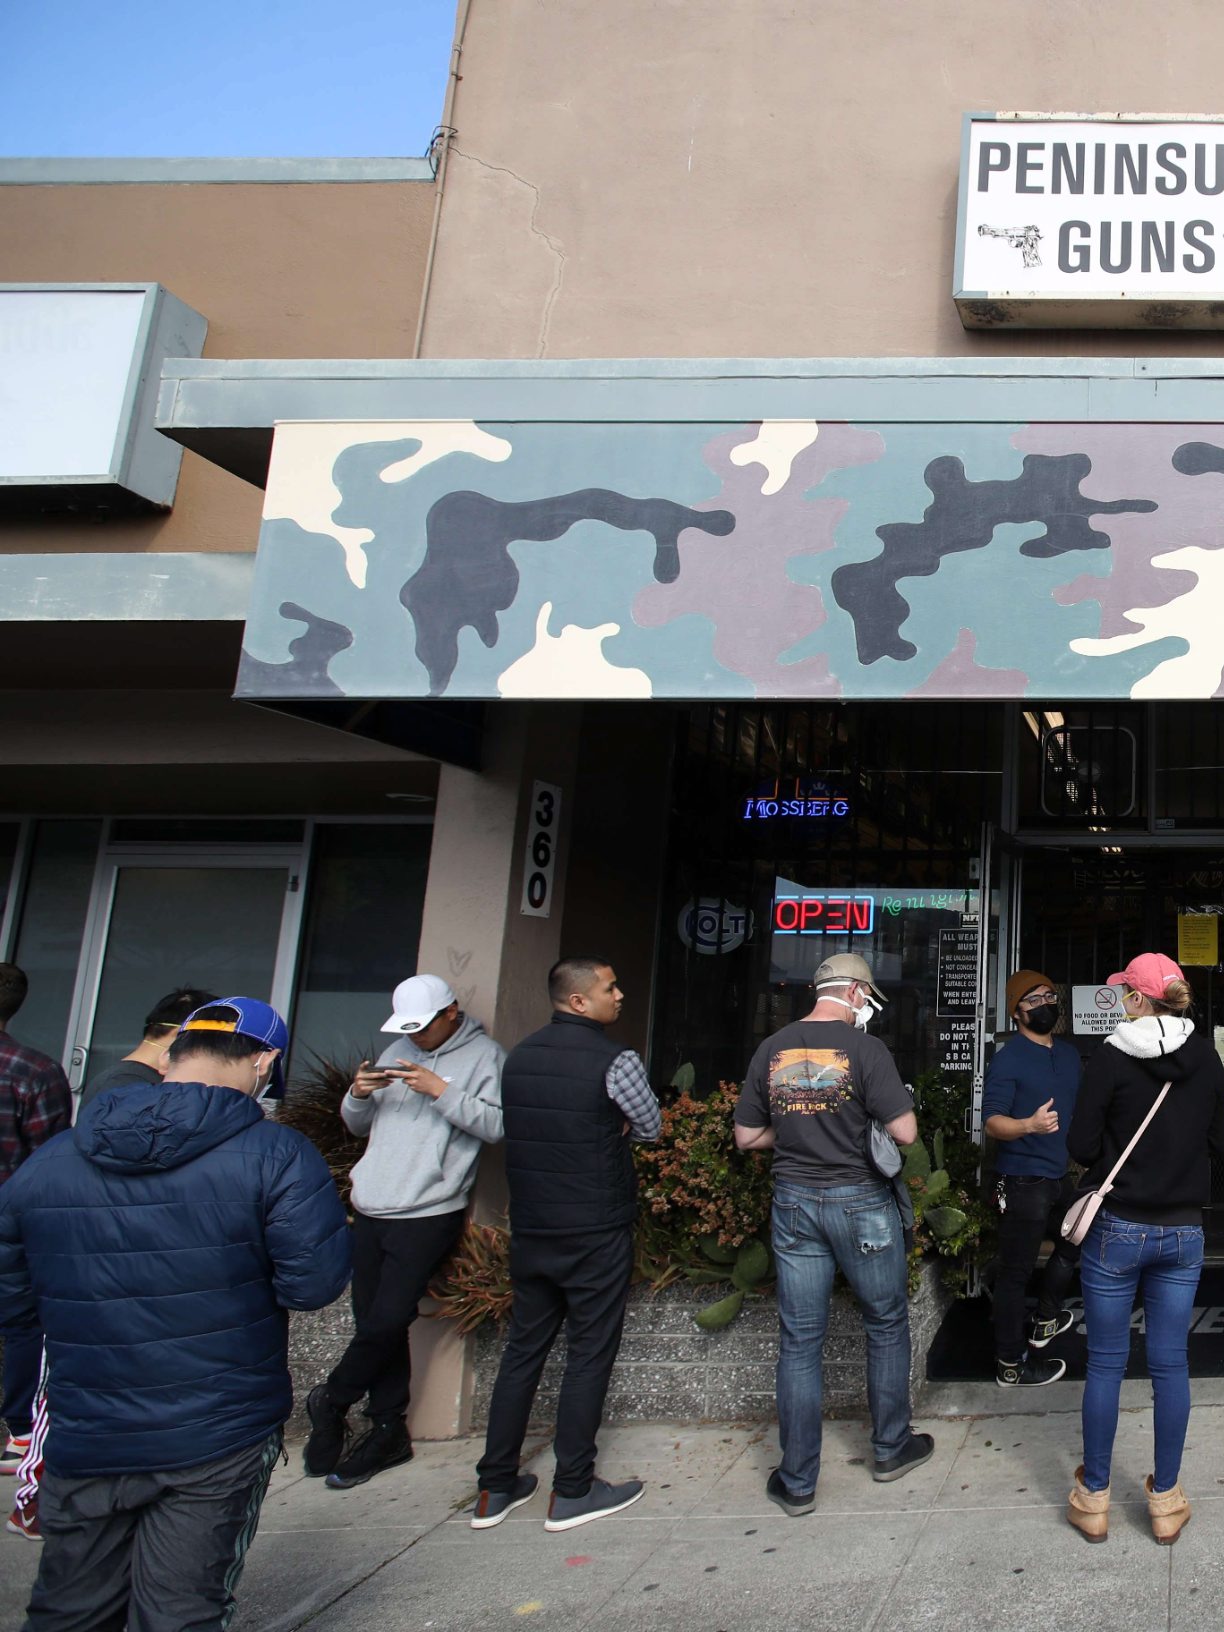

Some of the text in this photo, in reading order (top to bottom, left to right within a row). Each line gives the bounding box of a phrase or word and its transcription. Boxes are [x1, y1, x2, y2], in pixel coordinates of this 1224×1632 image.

[1057, 219, 1215, 274] GUNS
[527, 790, 554, 909] 360
[776, 900, 868, 930] OPEN
[942, 933, 955, 941] ALL
[951, 1023, 976, 1031] PLEAS
[953, 1033, 969, 1041] NOT
[787, 1103, 807, 1112] FIRE
